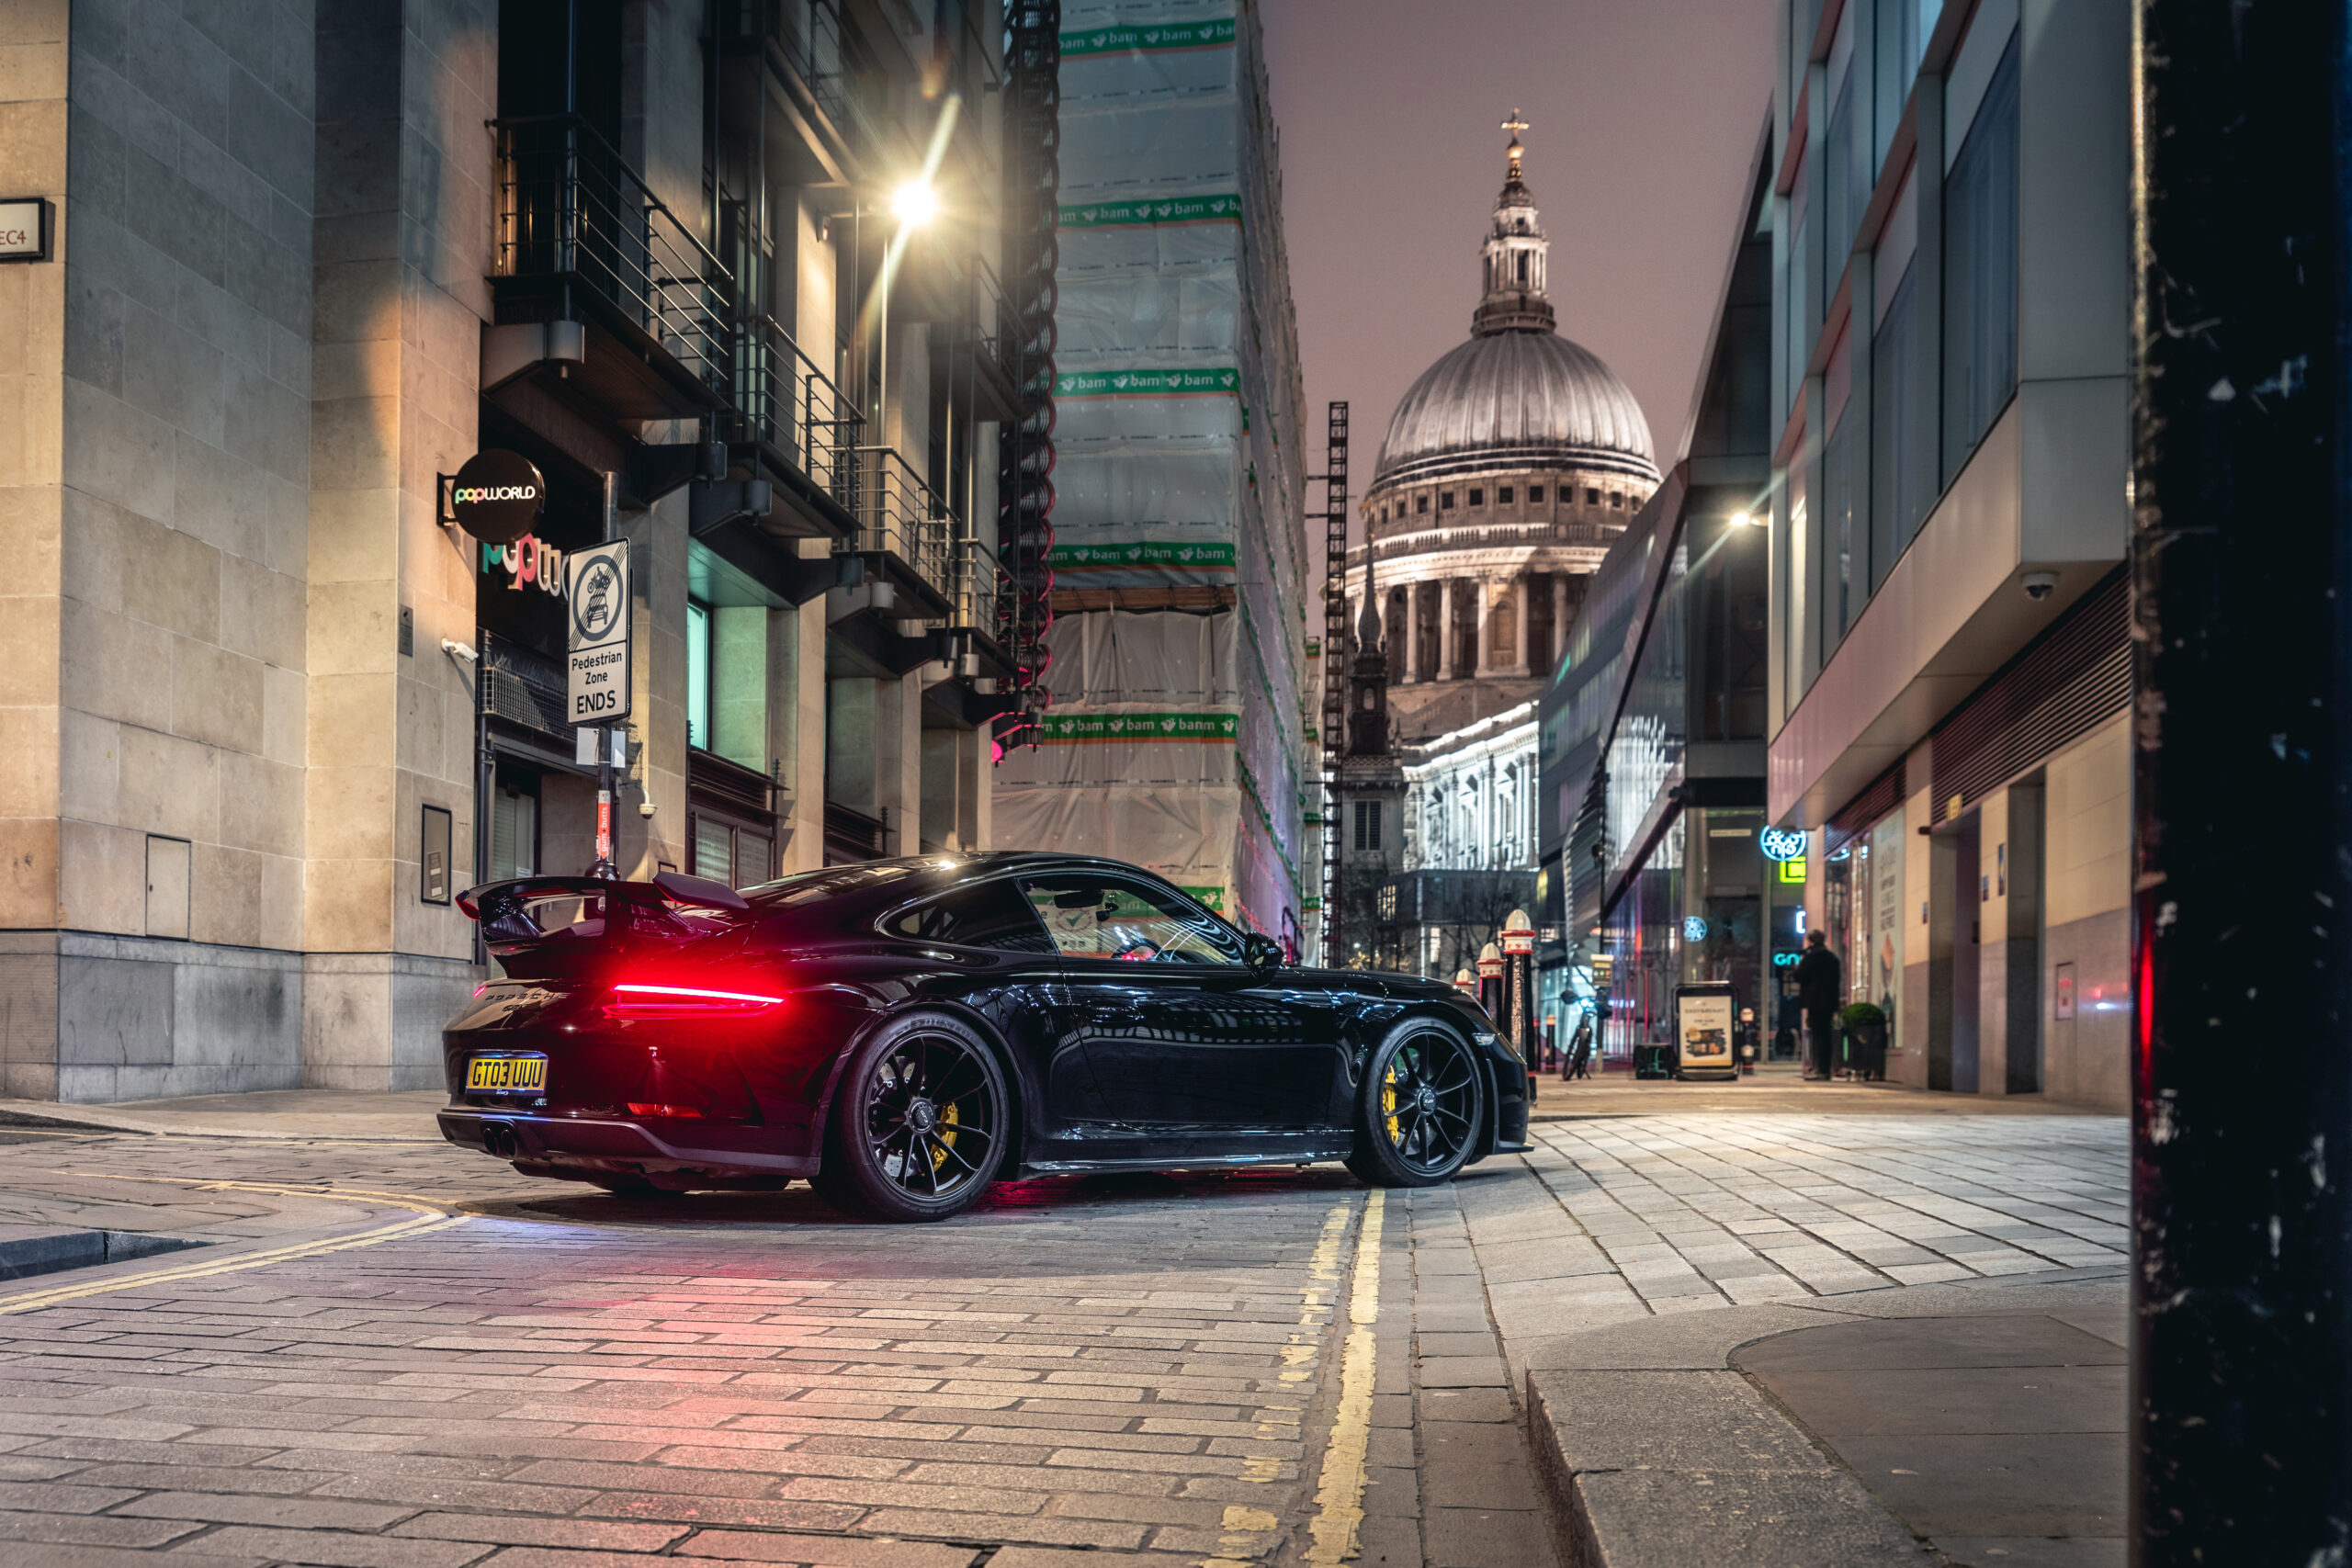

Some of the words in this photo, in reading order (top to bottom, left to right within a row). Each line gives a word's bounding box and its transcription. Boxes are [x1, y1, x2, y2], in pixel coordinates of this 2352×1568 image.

[1109, 32, 1137, 43] bam
[1162, 29, 1192, 40] bam
[1101, 208, 1129, 220] bam
[1174, 203, 1204, 215] bam
[0, 230, 27, 245] EC4
[1078, 376, 1105, 389] bam
[1130, 374, 1159, 387] bam
[1184, 373, 1214, 386] bam
[1092, 549, 1120, 560] bam
[1144, 547, 1171, 558] bam
[1196, 547, 1226, 559] bam
[572, 651, 622, 671] Pedestrian
[585, 671, 608, 685] Zone
[577, 690, 616, 715] ENDS
[1077, 719, 1103, 731] bam
[1126, 719, 1154, 730] bam
[472, 1061, 511, 1087] GT03
[512, 1061, 544, 1088] UUU
